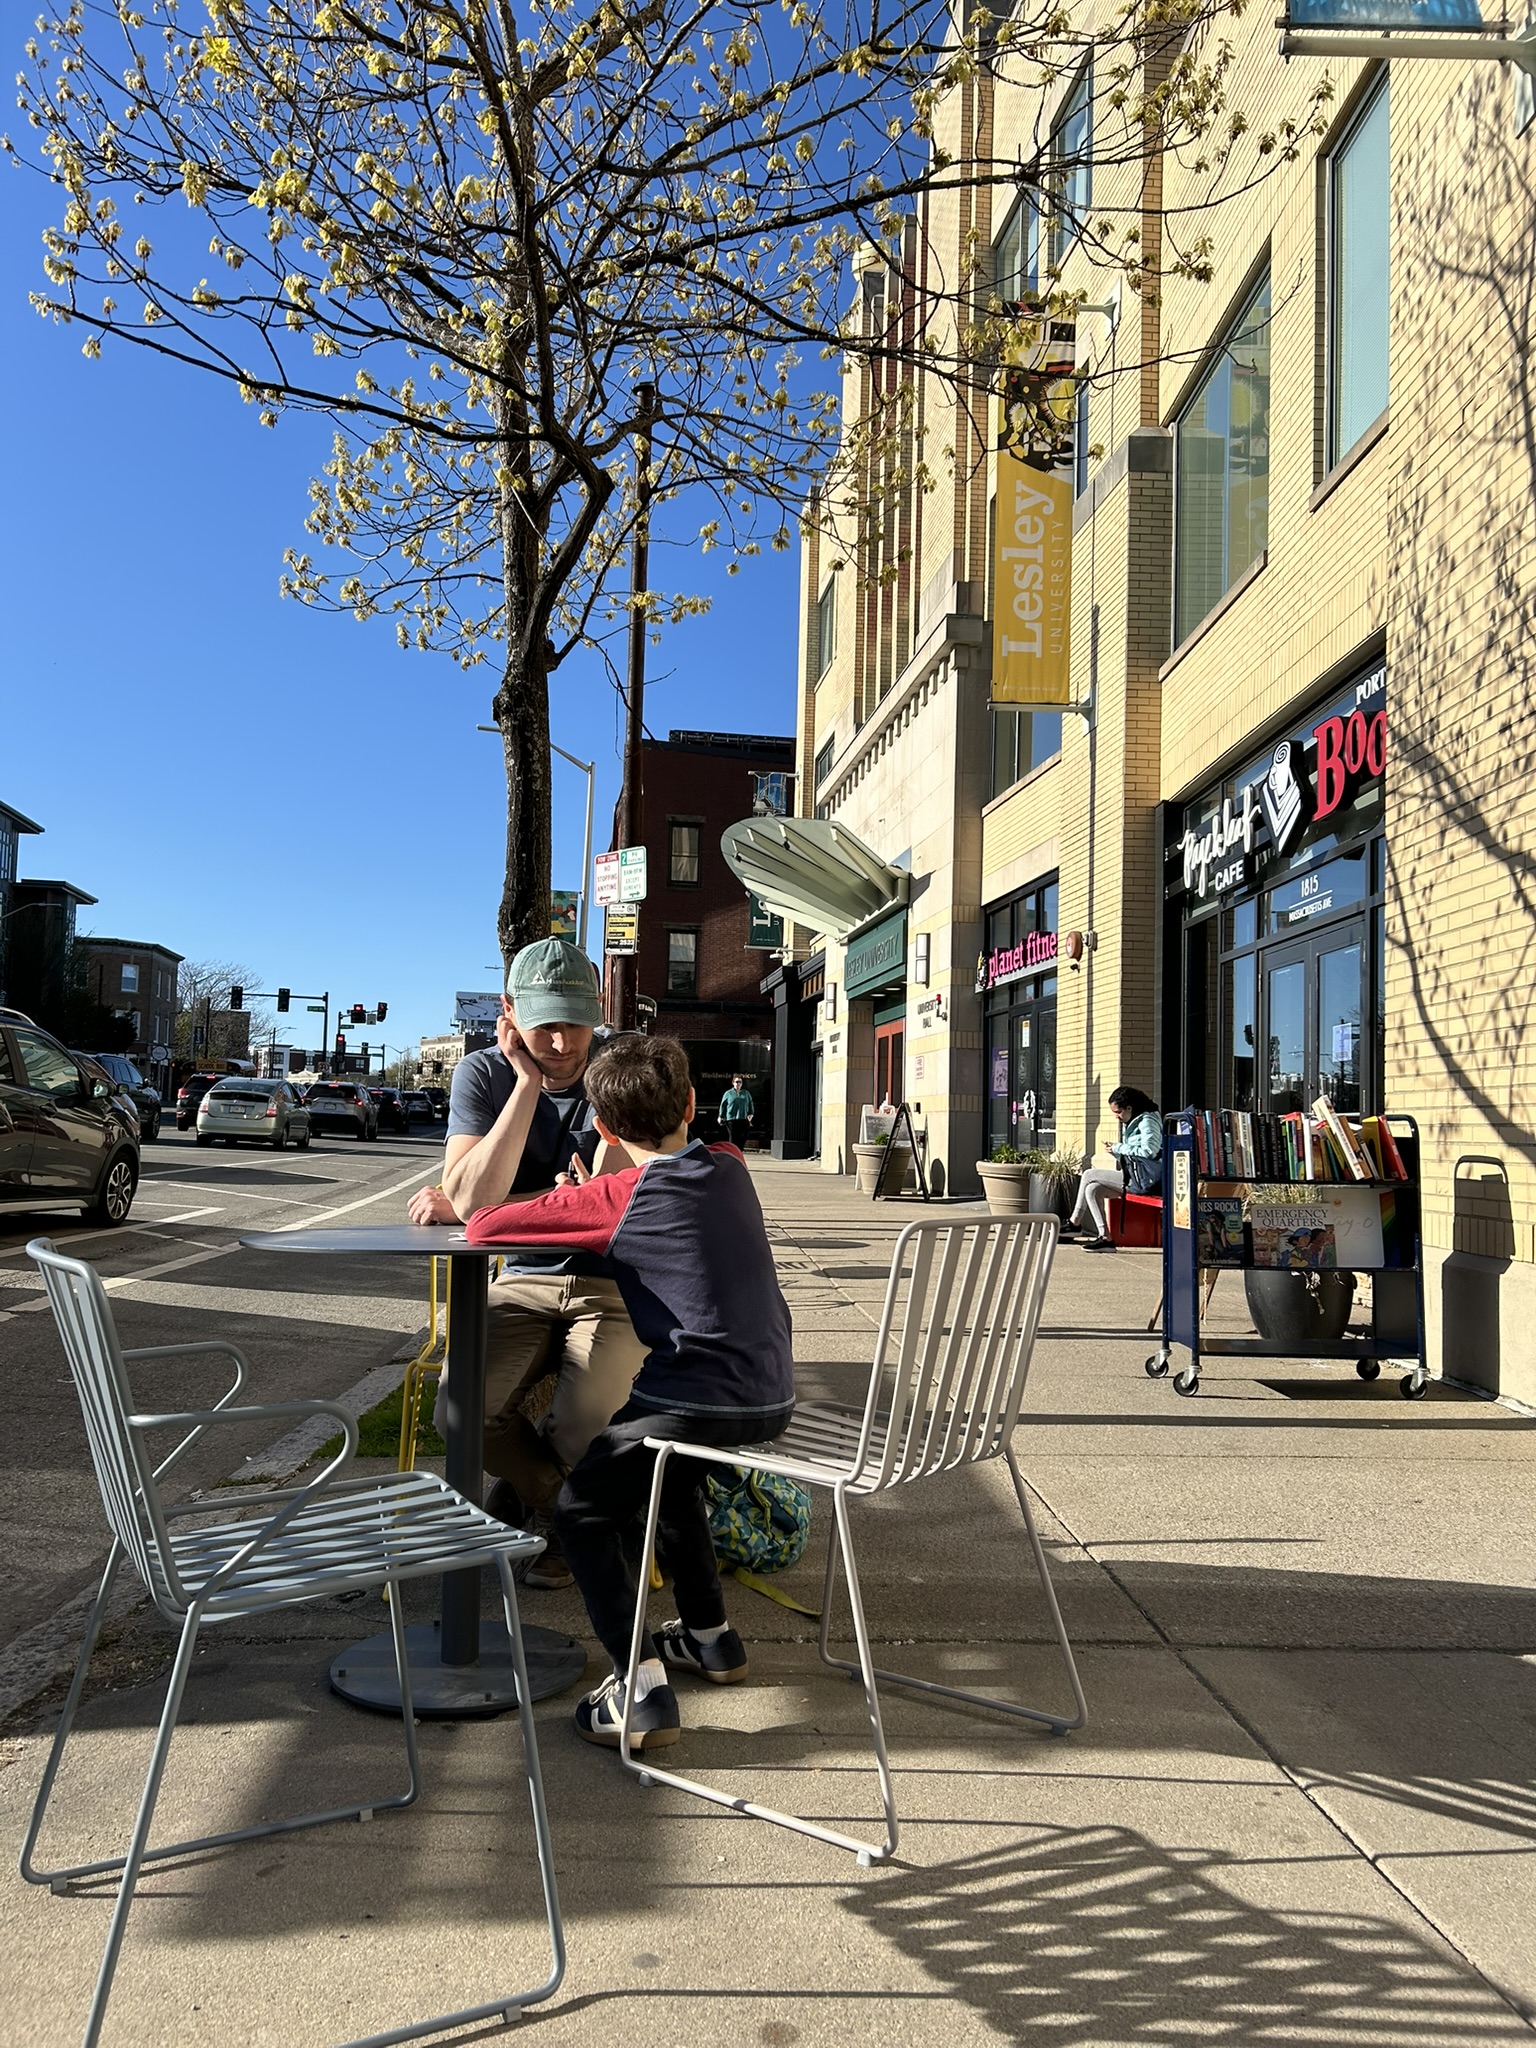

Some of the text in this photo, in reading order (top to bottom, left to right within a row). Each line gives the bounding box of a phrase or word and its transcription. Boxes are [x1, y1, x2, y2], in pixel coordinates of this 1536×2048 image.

[1002, 479, 1055, 658] Lesley
[1050, 520, 1064, 654] UNIVERSITY
[621, 852, 627, 865] 2
[597, 873, 618, 882] STOPPING
[1215, 859, 1244, 891] CAFE
[597, 883, 617, 892] ANYTIME
[1301, 874, 1319, 898] 1815
[988, 930, 1058, 988] planet fitne
[1214, 1201, 1239, 1213] ROCK!
[1256, 1208, 1329, 1219] EMERGENCY
[1262, 1217, 1325, 1229] QUARTERS
